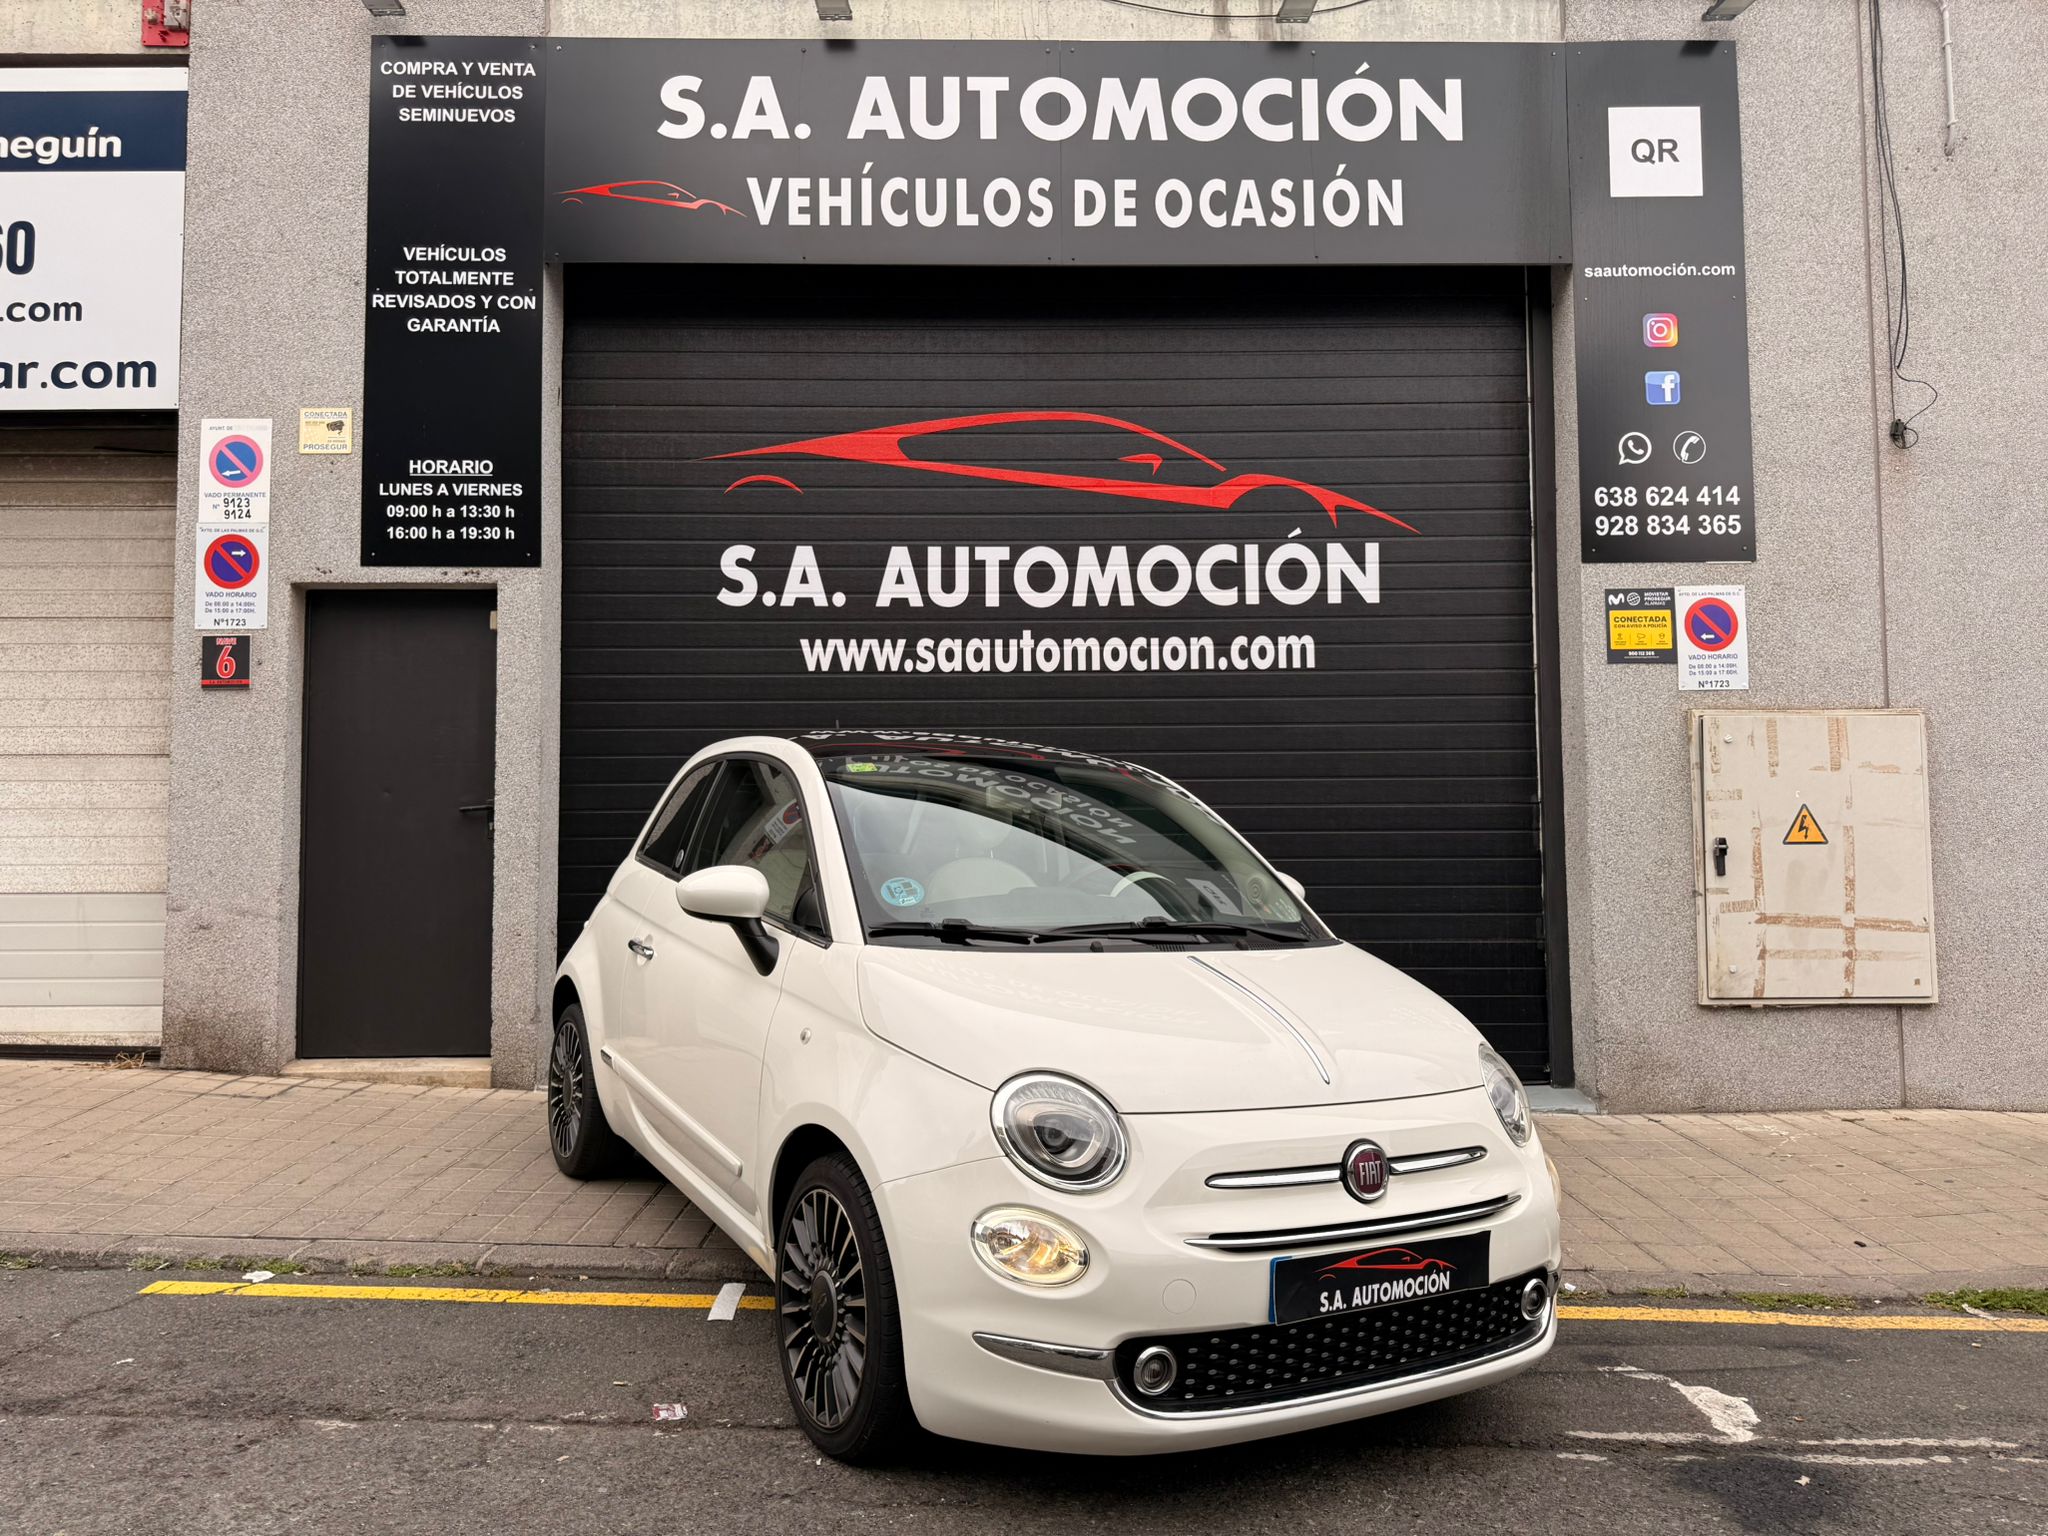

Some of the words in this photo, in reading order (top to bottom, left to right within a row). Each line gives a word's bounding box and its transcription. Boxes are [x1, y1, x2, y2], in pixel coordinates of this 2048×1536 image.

[380, 61, 458, 76] COMPRA
[462, 62, 474, 76] Y
[477, 62, 537, 77] VENTA
[392, 85, 417, 99] DE
[421, 81, 524, 100] VEHÍCULOS
[657, 75, 812, 140] S.A.
[847, 61, 1464, 142] AUTOMOCIÓN
[398, 108, 516, 123] SEMINUEVOS
[1631, 138, 1680, 165] QR
[747, 162, 1054, 228] VEHÍCULOS
[1074, 178, 1137, 227] DE
[1155, 164, 1404, 229] OCASIÓN
[402, 245, 507, 262] VEHÍCULOS
[394, 270, 515, 286] TOTALMENTE
[1584, 262, 1736, 278] saautomoción.com
[372, 294, 476, 309] REVISADOS
[481, 295, 493, 309] Y
[497, 296, 536, 310] CON
[406, 315, 501, 333] GARANTÍA
[303, 443, 348, 451] PROSEGUR
[409, 460, 494, 474] HORARIO
[379, 483, 434, 496] LUNES
[437, 484, 449, 496] A
[452, 484, 523, 497] VIERNES
[1594, 486, 1638, 507] 638
[1645, 486, 1690, 507] 624
[1696, 485, 1741, 506] 414
[223, 497, 250, 508] 9123
[224, 508, 252, 519] 9124
[386, 505, 428, 518] 09:00
[432, 505, 442, 518] h
[446, 508, 456, 518] a
[460, 505, 501, 518] 13:30
[505, 505, 515, 518] h
[1595, 515, 1639, 536] 928
[1646, 515, 1691, 536] 834
[1698, 514, 1742, 535] 365
[386, 527, 428, 540] 16:00
[432, 527, 442, 540] h
[446, 530, 455, 540] a
[460, 527, 501, 540] 19:30
[505, 527, 515, 540] h
[717, 545, 847, 608] S.A.
[875, 527, 1380, 608] AUTOMOCIÓN
[1613, 615, 1668, 623] CONECTADA
[799, 629, 1316, 673] www.saautomocion.com
[216, 645, 237, 679] 6
[1358, 1160, 1382, 1186] FIAT
[1319, 1289, 1347, 1313] S.A.
[1351, 1269, 1451, 1308] AUTOMOCIÓN
